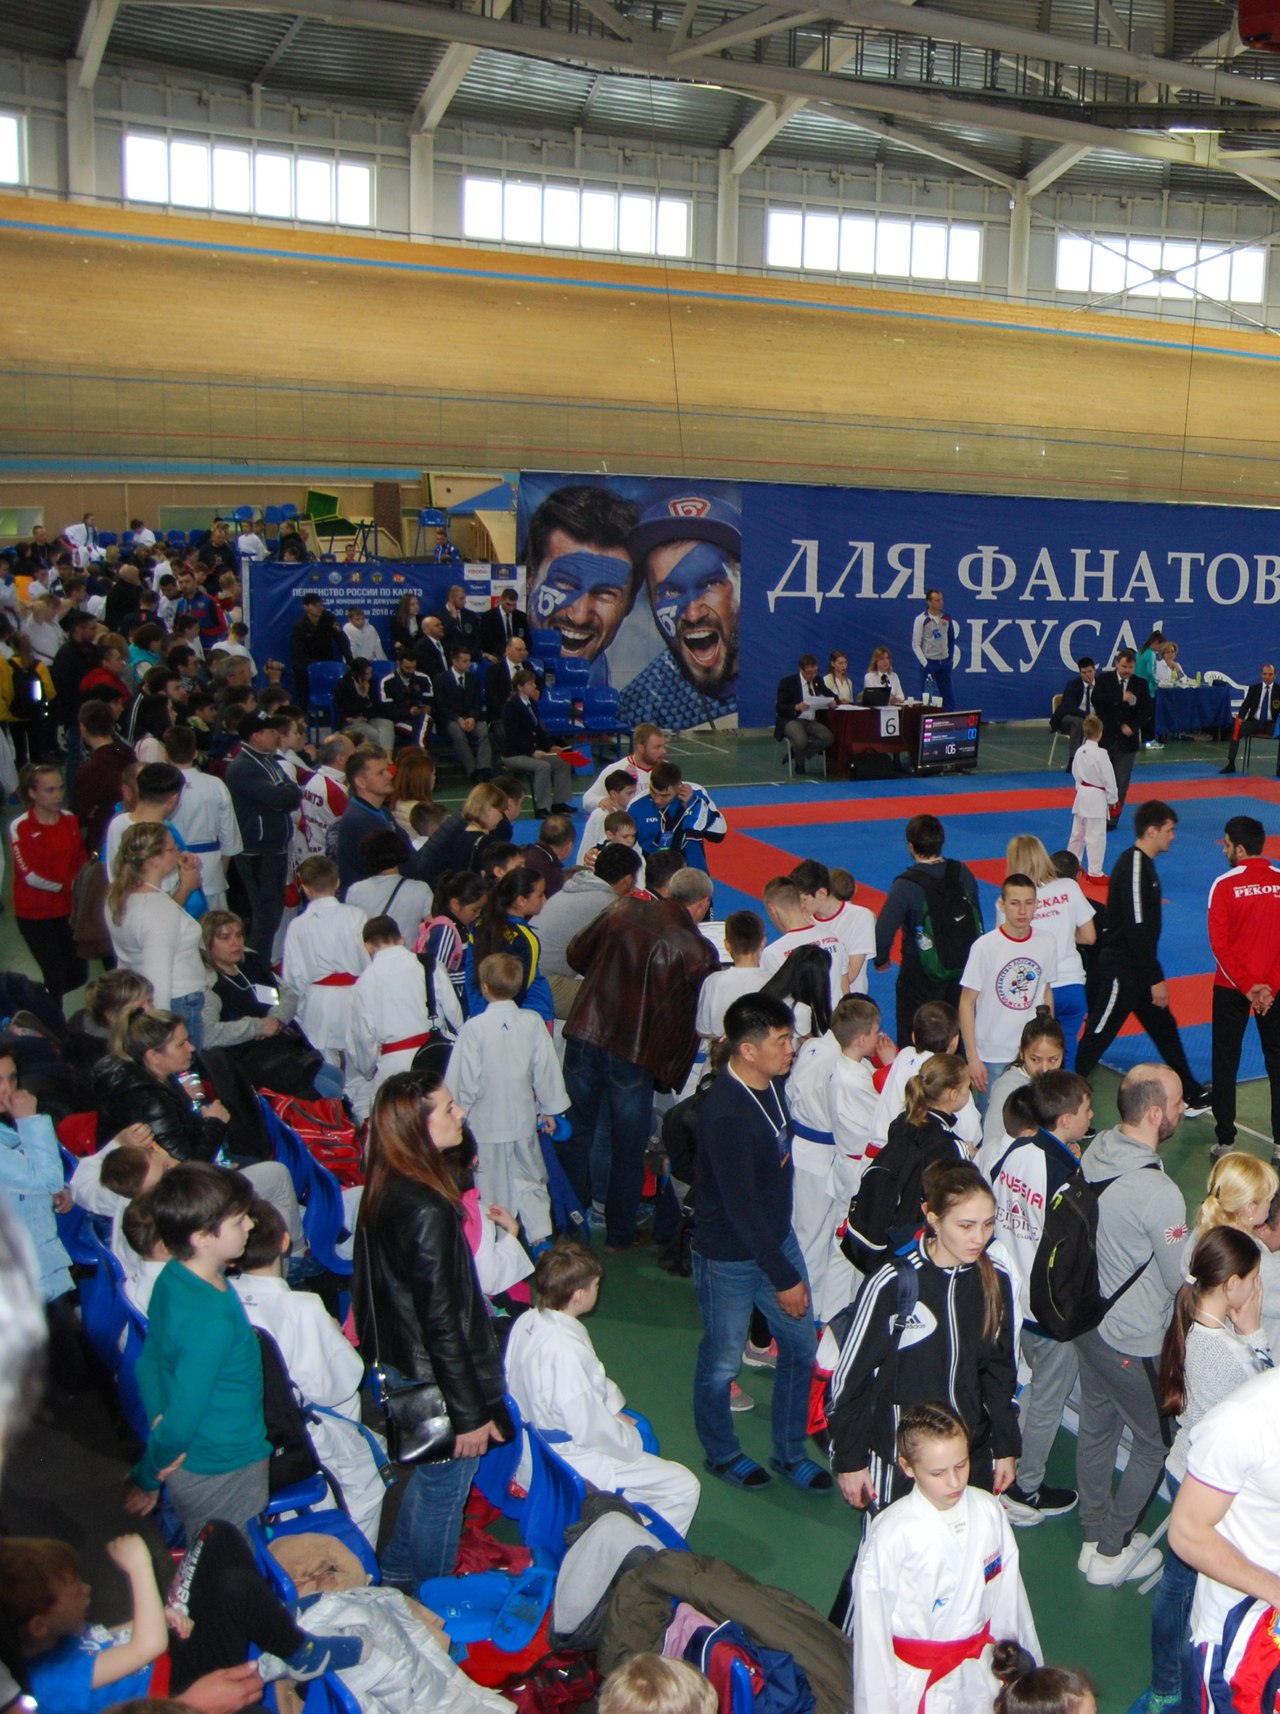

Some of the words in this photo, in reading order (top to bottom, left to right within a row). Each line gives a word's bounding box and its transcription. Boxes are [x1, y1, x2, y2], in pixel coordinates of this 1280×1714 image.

[767, 539, 931, 613] ДЛЯ
[951, 617, 1163, 673] КУСА
[885, 717, 897, 735] 6
[999, 1170, 1044, 1210] RUSSIA
